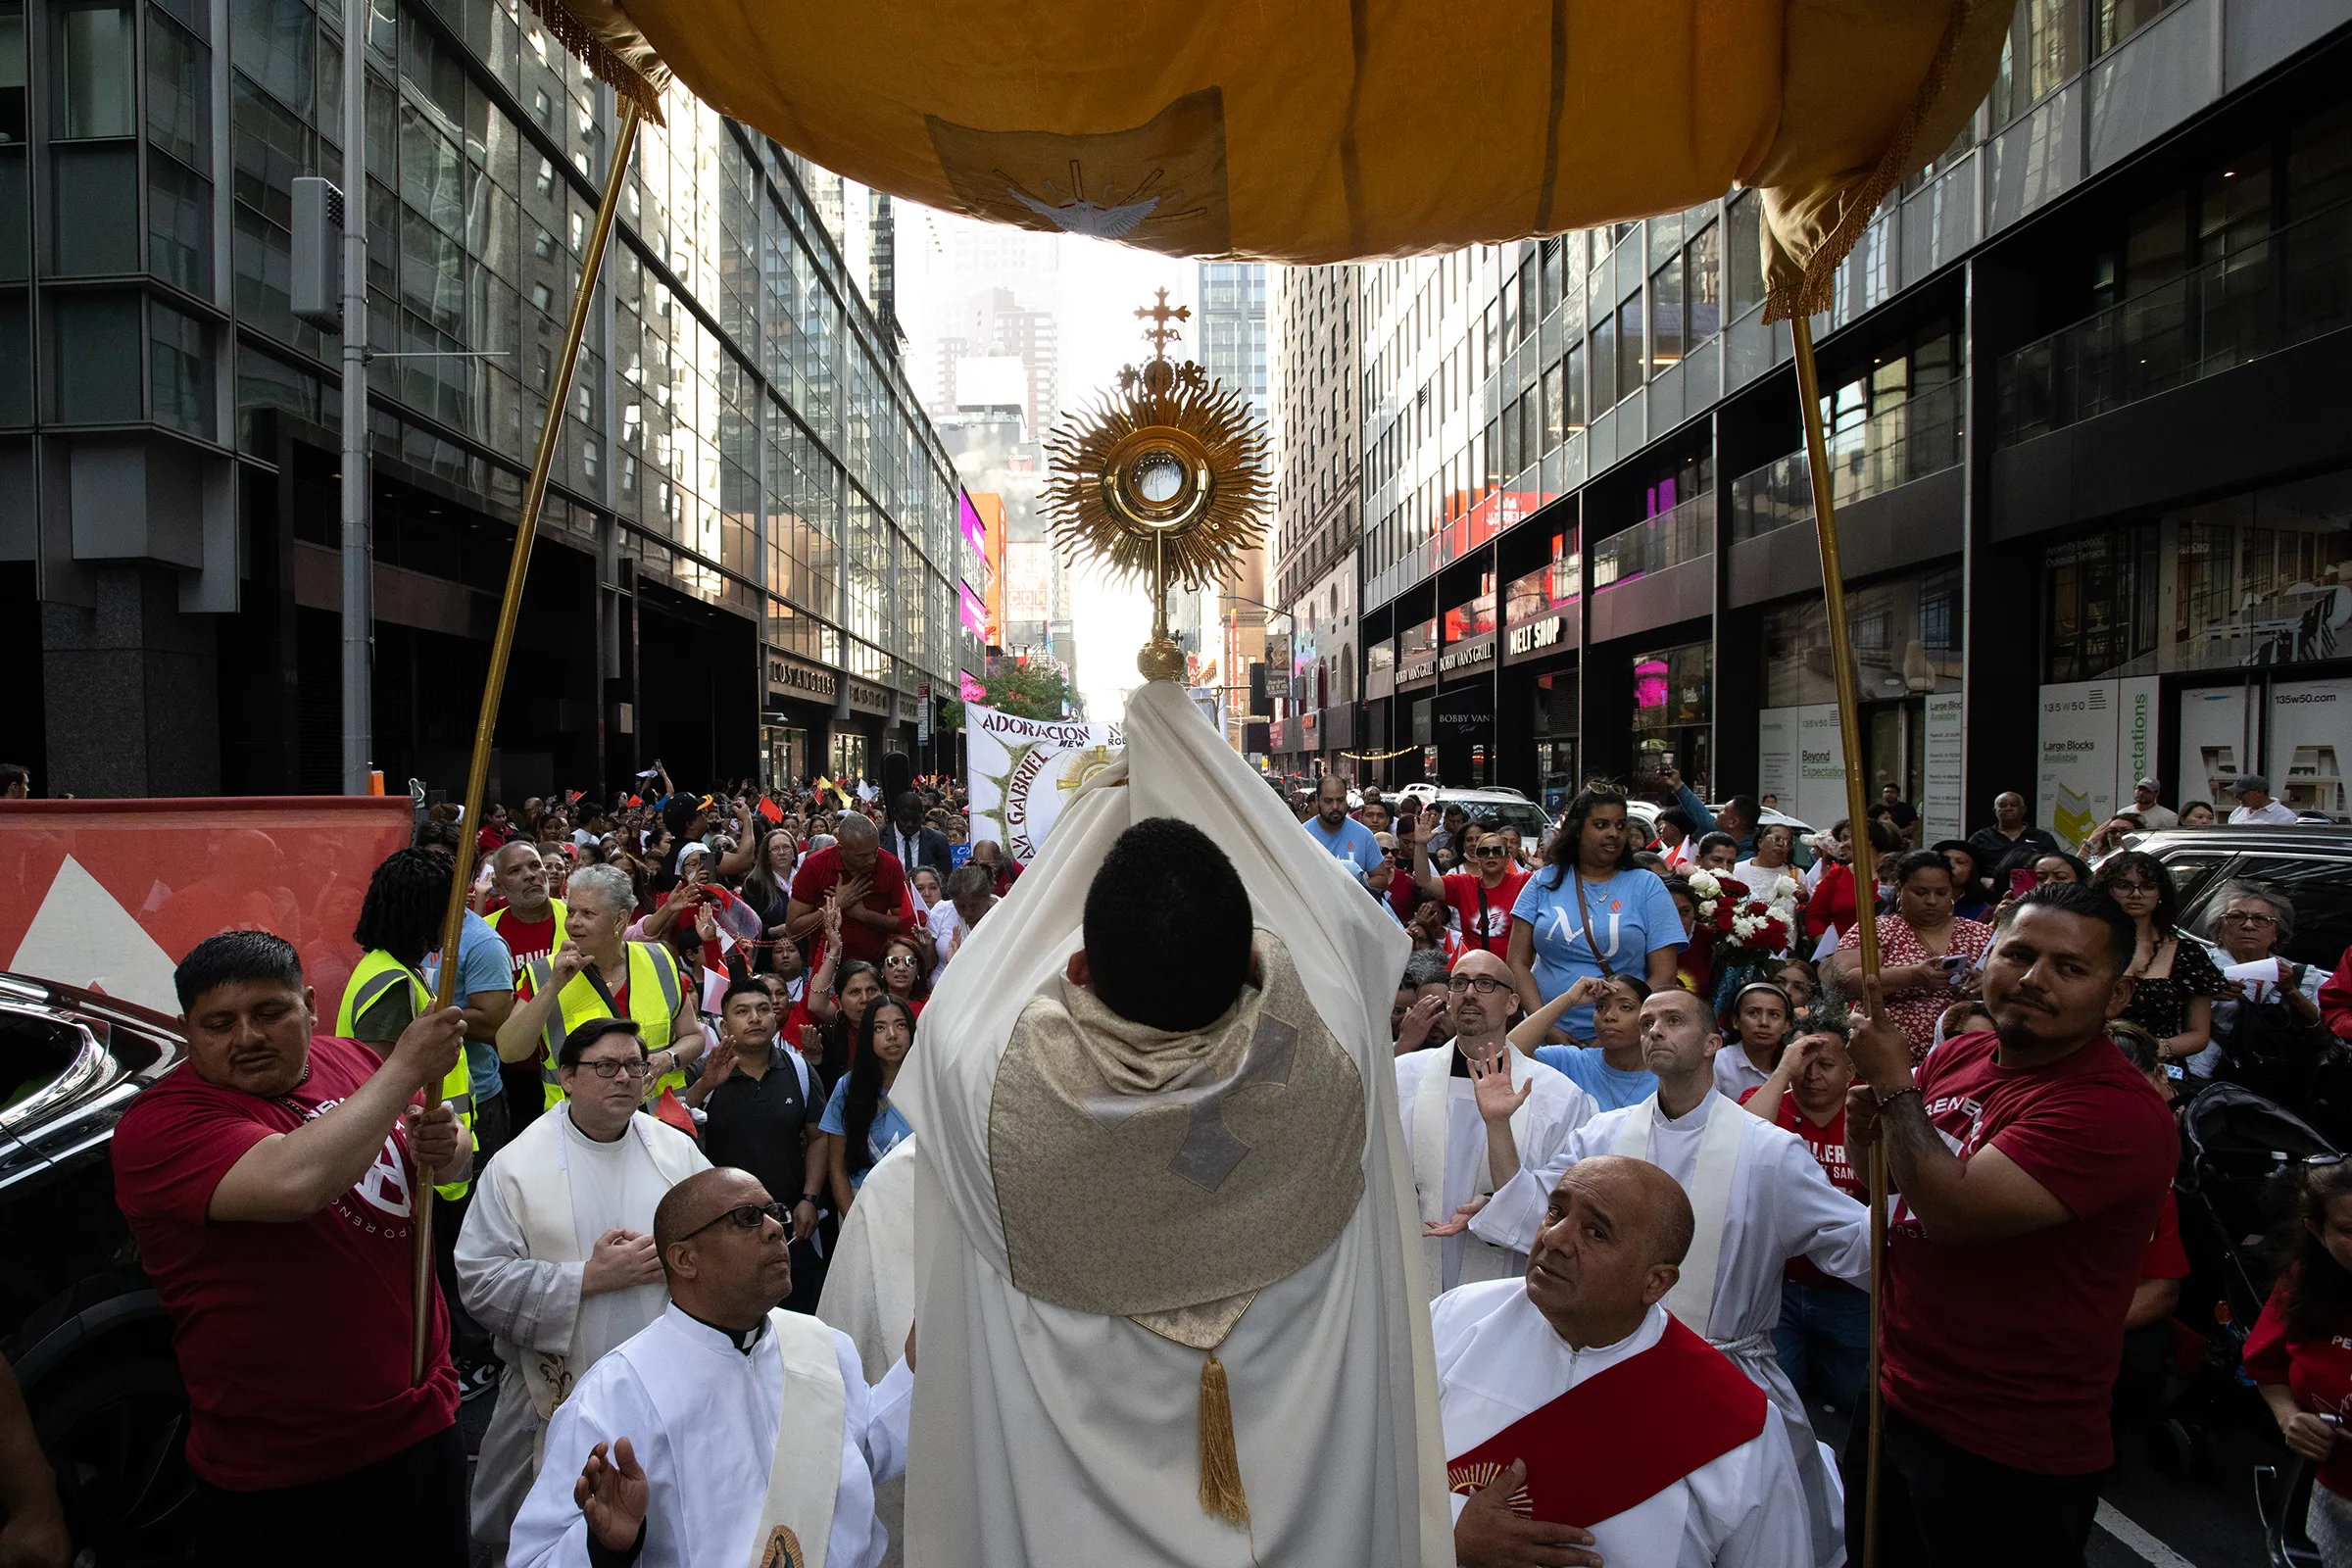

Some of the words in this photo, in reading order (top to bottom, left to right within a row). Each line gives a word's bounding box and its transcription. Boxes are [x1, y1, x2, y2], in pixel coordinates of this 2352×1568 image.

[1510, 624, 1533, 656] MELT
[1534, 615, 1560, 649] SHOP
[1473, 642, 1493, 662] GRILL
[771, 661, 793, 685] LOS
[796, 667, 836, 696] ANGELES
[2276, 693, 2336, 705] 135w50.com
[1440, 713, 1469, 723] BOBBY
[982, 713, 1091, 742] ADORACION
[1058, 738, 1086, 749] NEW
[2043, 741, 2066, 752] Large
[2067, 740, 2095, 751] Blocks
[2132, 693, 2146, 787] ectations
[1801, 750, 1831, 763] Beyond
[2043, 753, 2079, 763] Available
[1006, 750, 1049, 825] GABRIEL
